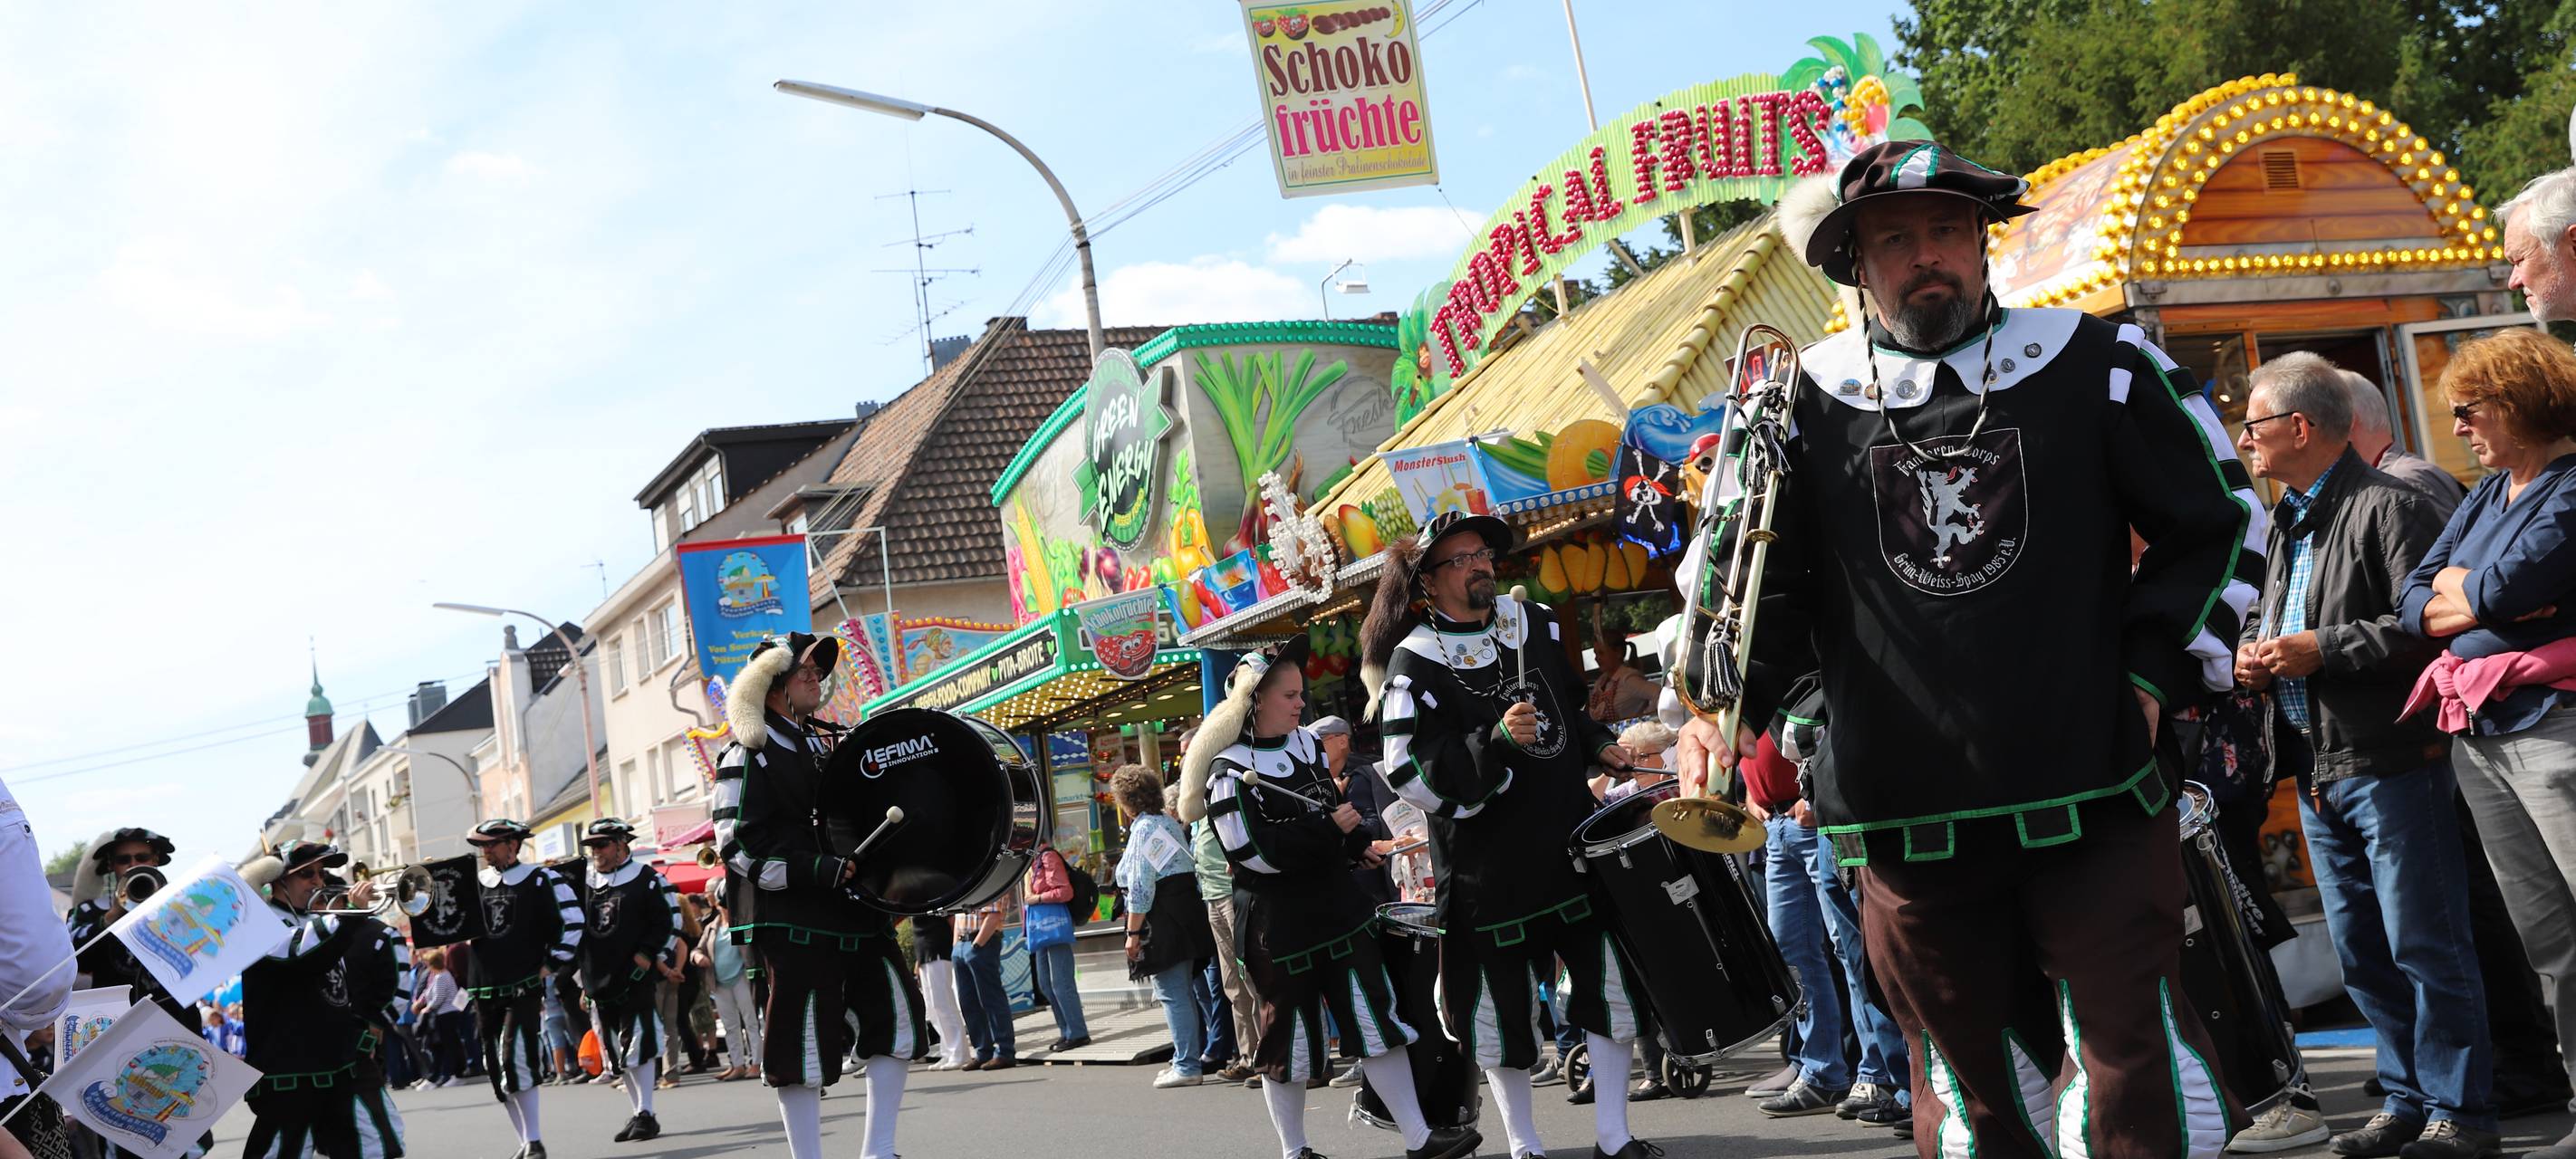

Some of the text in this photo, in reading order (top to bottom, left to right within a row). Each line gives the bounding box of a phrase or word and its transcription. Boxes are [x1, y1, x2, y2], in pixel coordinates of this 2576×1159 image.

[1263, 36, 1411, 97] Schoko
[1275, 94, 1421, 157] früchte
[1288, 167, 1298, 180] in
[1428, 91, 1832, 378] TROPICAL FRUITS
[1093, 386, 1140, 463] GREEN
[1098, 438, 1155, 532] ENERGY
[1983, 554, 2006, 575] 1985
[1085, 598, 1153, 631] Schokofrüchte
[889, 749, 934, 767] INNOVATION
